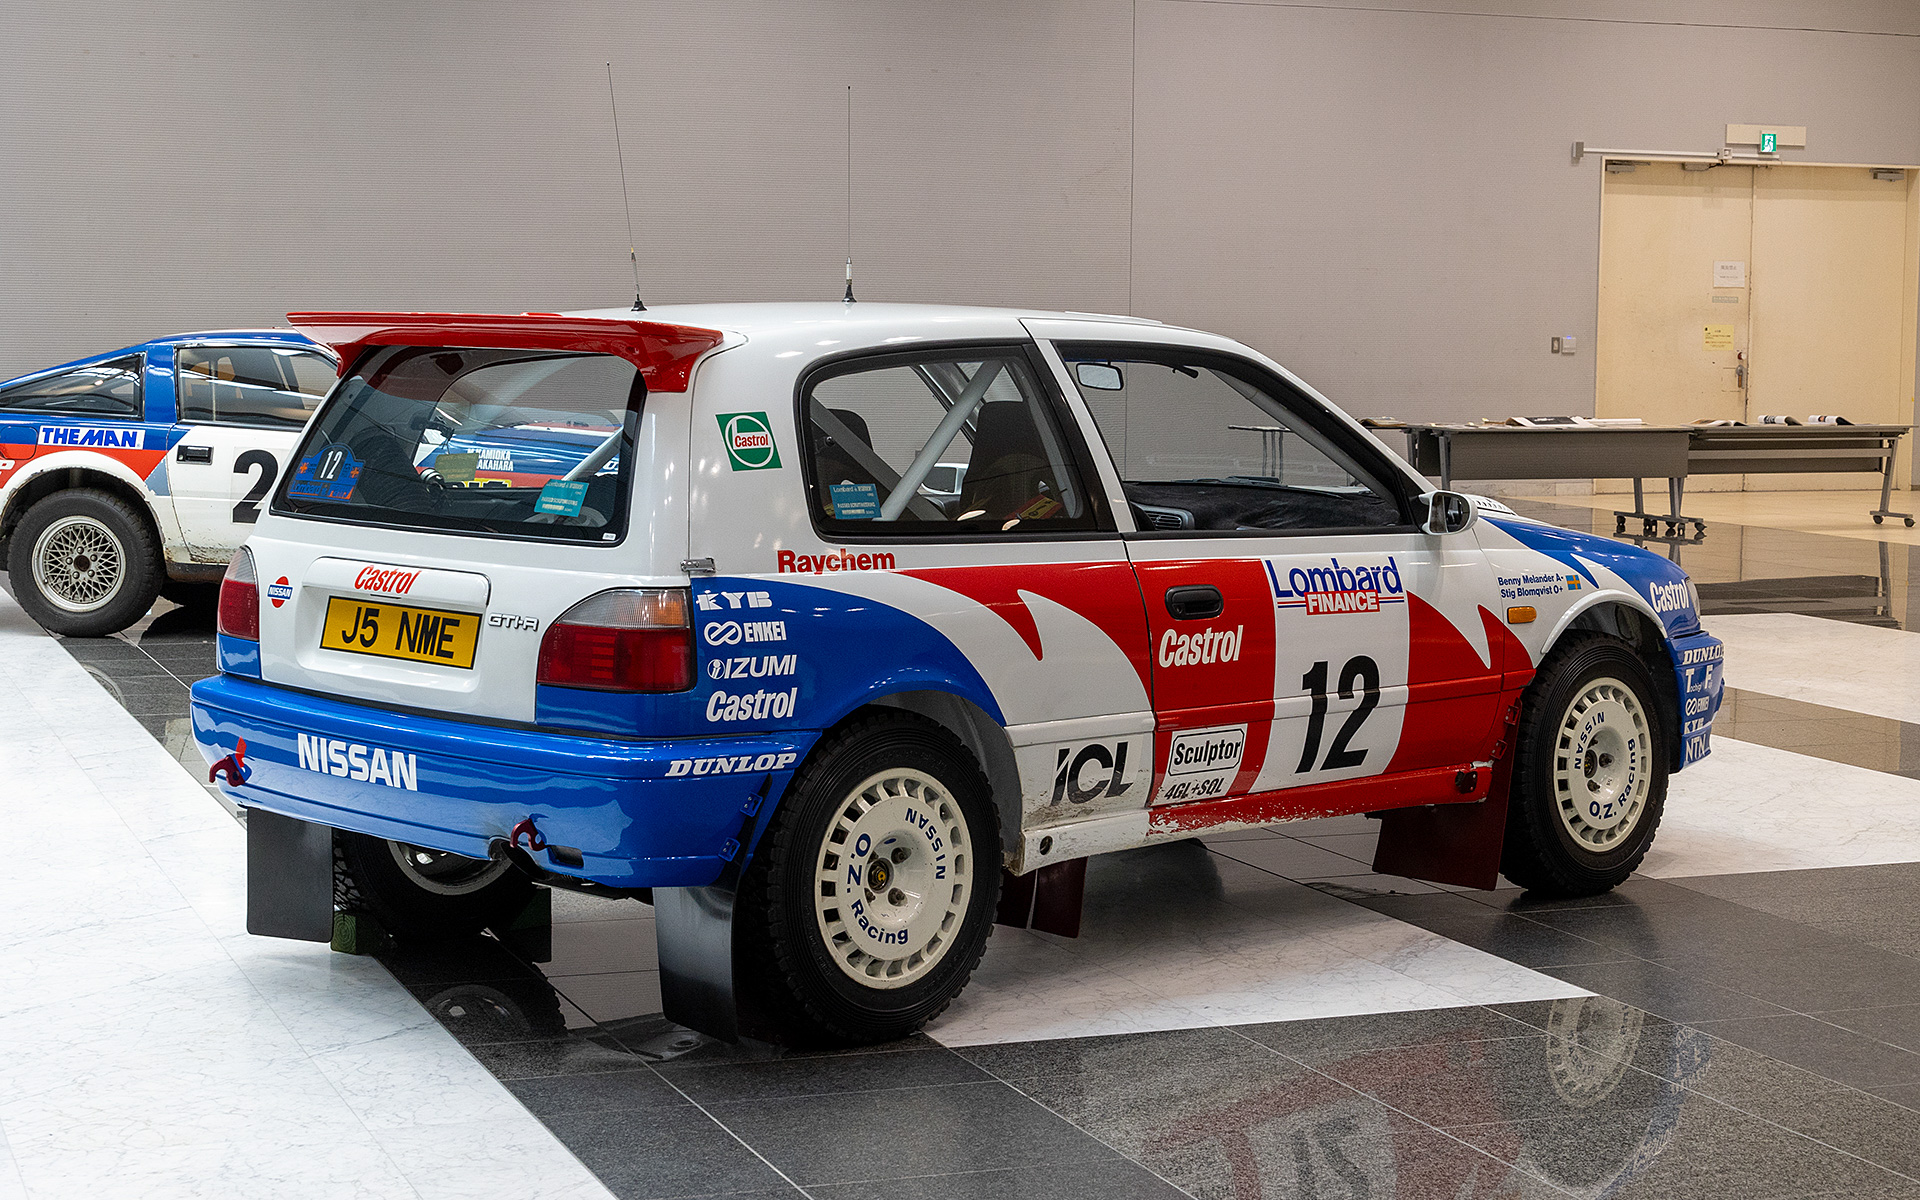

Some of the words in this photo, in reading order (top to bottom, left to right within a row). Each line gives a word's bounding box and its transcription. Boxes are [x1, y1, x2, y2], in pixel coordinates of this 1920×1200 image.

[734, 433, 769, 448] Castrol
[320, 450, 343, 480] 12
[232, 449, 279, 525] 2
[777, 548, 896, 575] Raychem
[268, 585, 293, 599] NISSAN
[354, 564, 422, 595] Castrol
[1265, 556, 1403, 599] Lombard
[1497, 576, 1521, 587] Benny
[1522, 573, 1555, 585] Melander
[1501, 588, 1516, 600] Stig
[1517, 585, 1553, 598] Blomqvist
[697, 590, 773, 611] KYB
[1306, 590, 1379, 613] FINANCE
[1649, 578, 1690, 614] Castrol
[341, 606, 380, 648] J5
[395, 610, 460, 660] NME
[743, 620, 787, 643] ENKEI
[1158, 624, 1244, 668] Castrol
[724, 654, 798, 679] IZUMI
[1682, 644, 1725, 665] DUNLO
[705, 687, 798, 723] Castrol
[1294, 655, 1380, 775] 12
[1173, 739, 1241, 767] Sculptor
[1574, 711, 1606, 770] NISSAN
[1685, 733, 1707, 762] NTN
[297, 732, 418, 791] NISSAN
[664, 752, 797, 777] DUNLOP
[1051, 742, 1135, 807] ICL
[1617, 738, 1637, 807] Racing
[1163, 777, 1225, 800] 4GL+SQL
[904, 807, 946, 880] NISSAN
[850, 899, 910, 945] Racing
